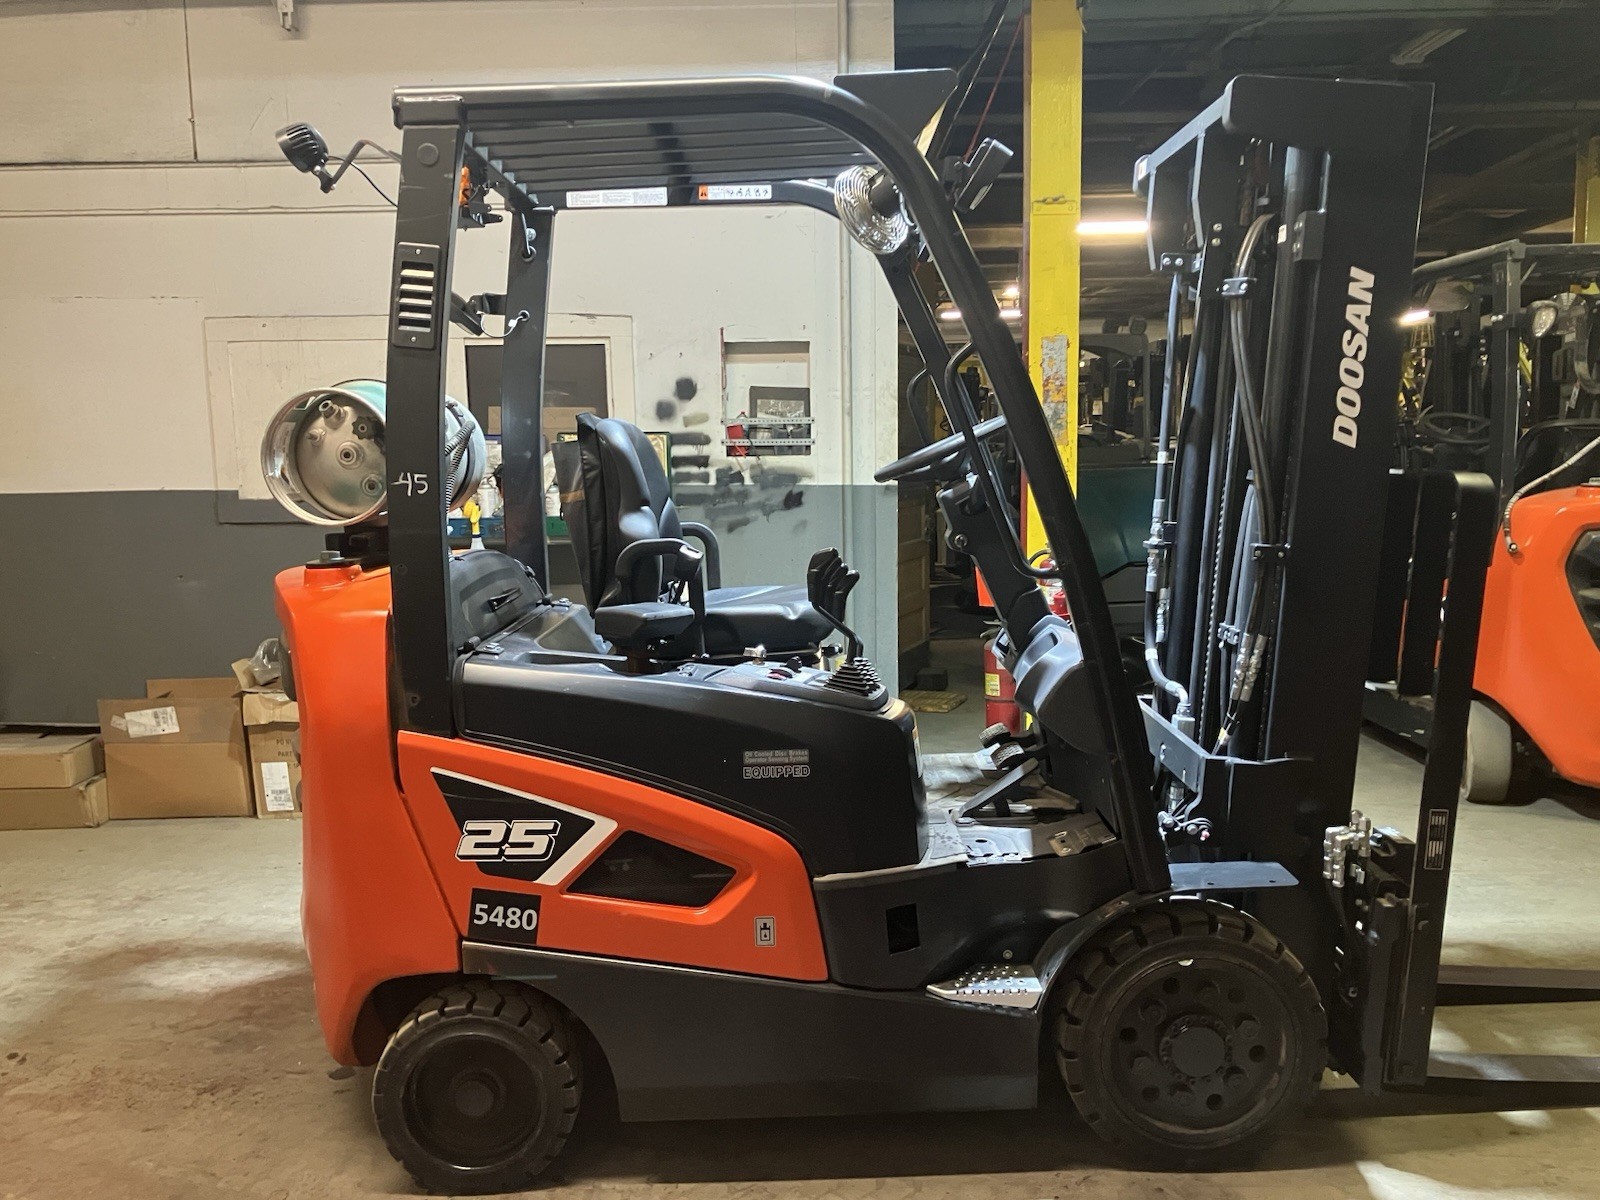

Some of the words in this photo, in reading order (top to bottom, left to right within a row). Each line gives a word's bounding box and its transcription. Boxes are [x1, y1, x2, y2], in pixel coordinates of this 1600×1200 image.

[1332, 265, 1375, 449] DOOSAN
[391, 471, 429, 497] 45
[743, 765, 810, 779] EQUIPPED
[789, 755, 808, 763] System
[455, 820, 561, 862] 25
[473, 903, 538, 931] 5480
